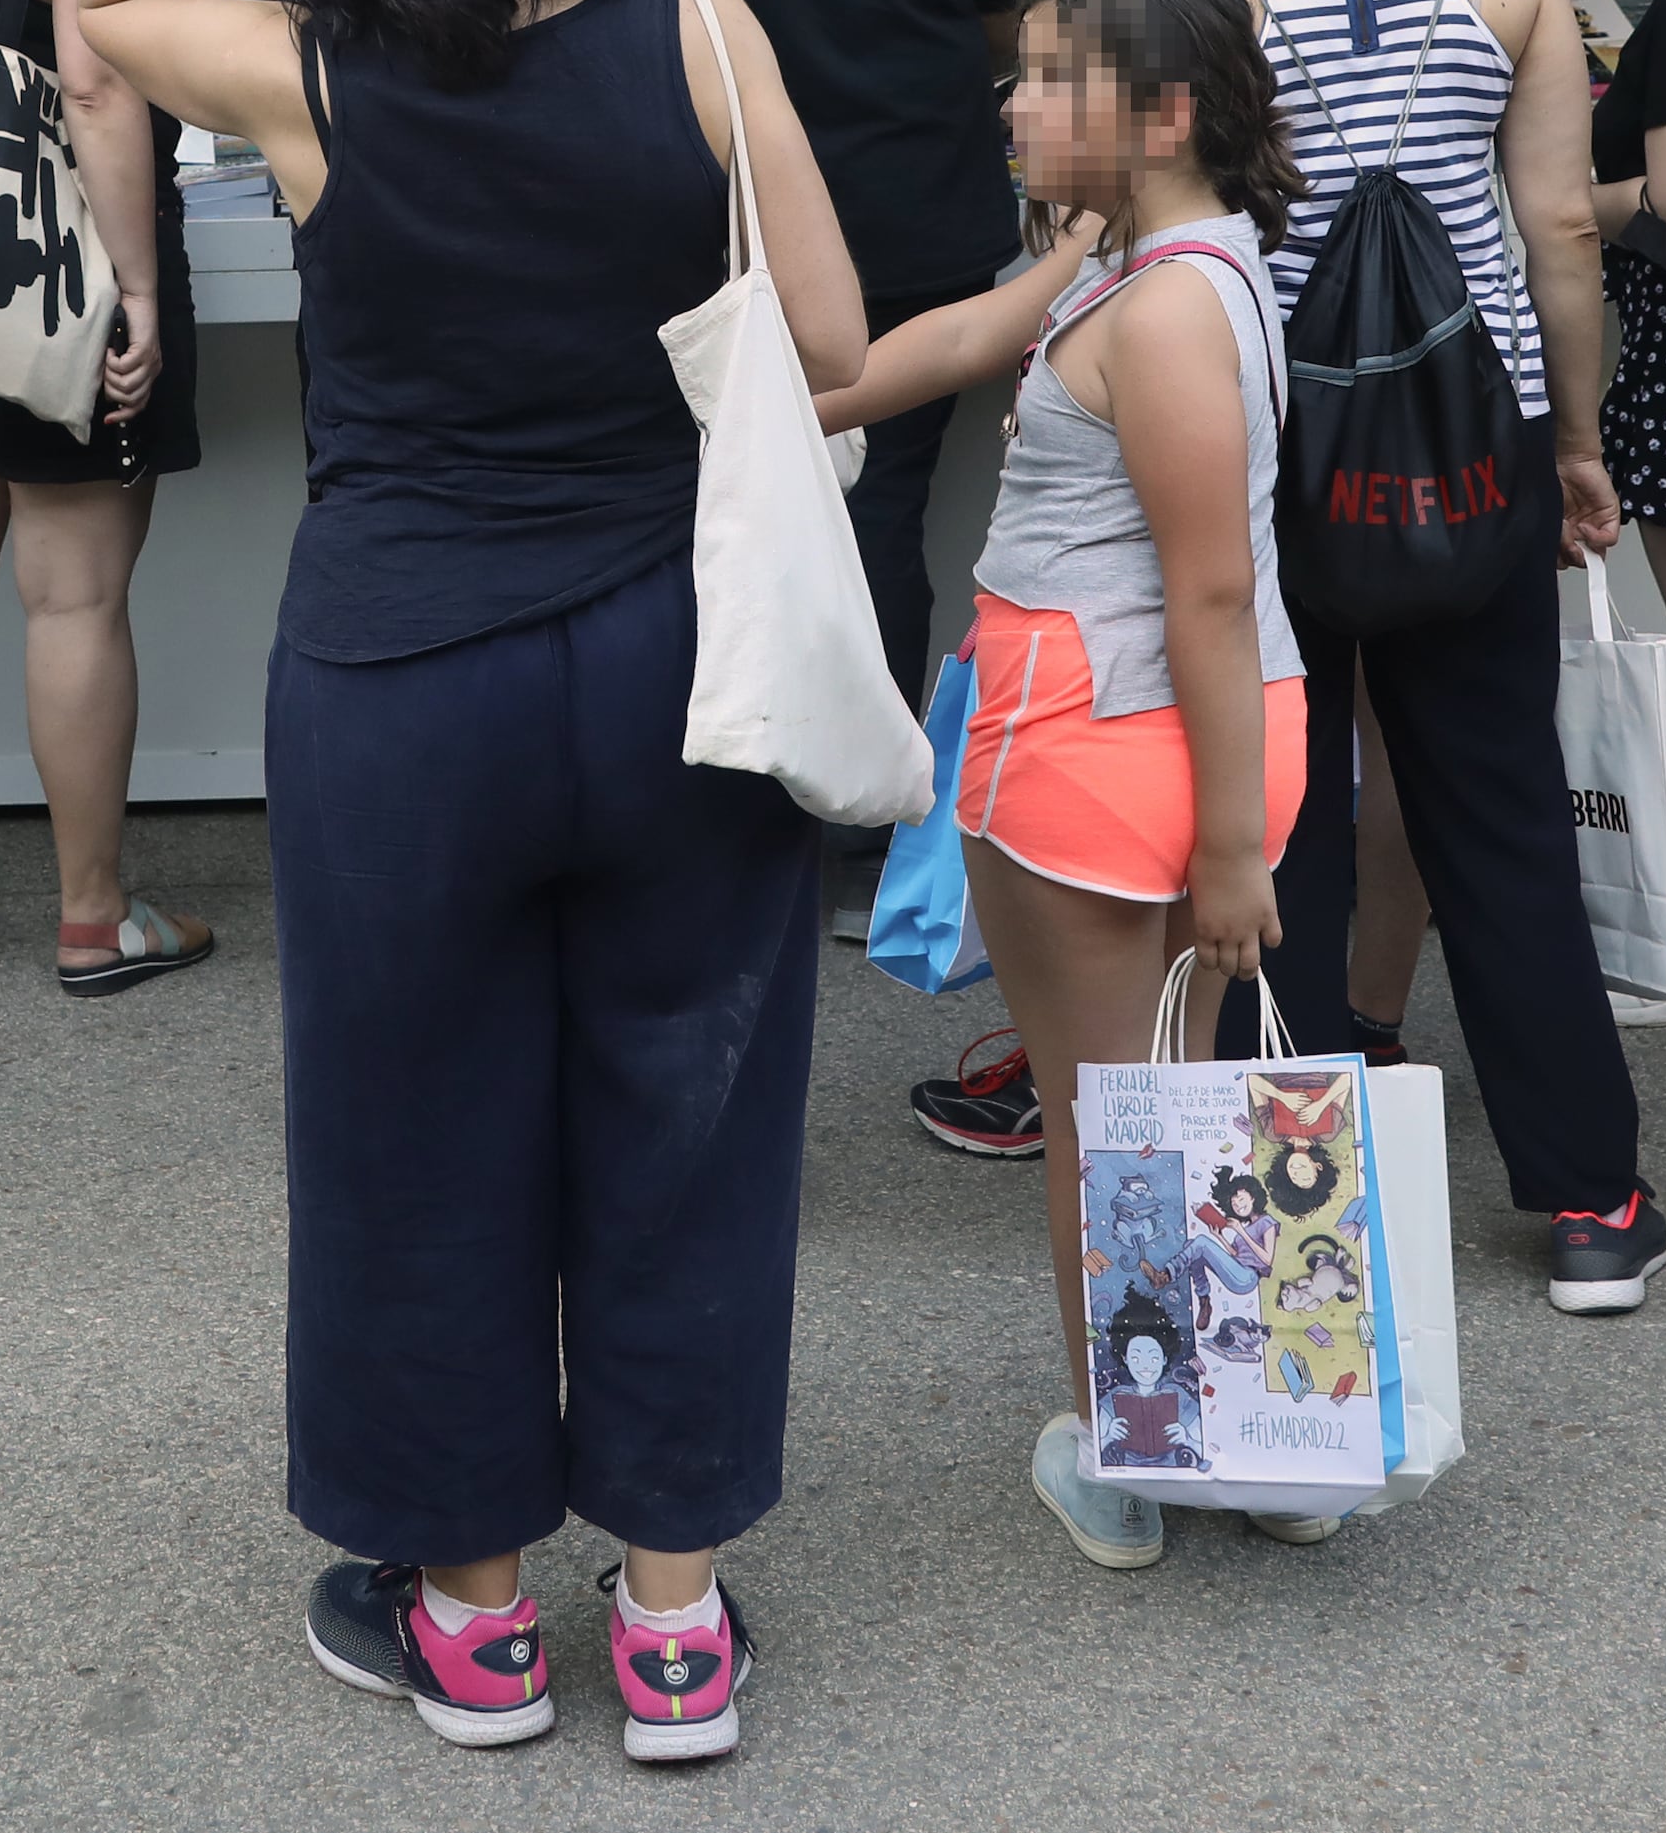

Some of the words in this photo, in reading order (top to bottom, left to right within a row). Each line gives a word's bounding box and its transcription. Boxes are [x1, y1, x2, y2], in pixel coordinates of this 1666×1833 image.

[1329, 454, 1508, 527] NETFLIX
[1567, 789, 1630, 834] BERRI
[1100, 1068, 1137, 1094] FERIA
[1139, 1069, 1161, 1094] DEL
[1168, 1086, 1184, 1097] DEL
[1186, 1086, 1199, 1096] 27
[1200, 1086, 1211, 1096] DE
[1212, 1085, 1237, 1096] MAYO
[1104, 1095, 1142, 1118] LIBRO
[1143, 1096, 1158, 1116] DE
[1171, 1098, 1183, 1107] AL
[1186, 1098, 1196, 1108] 12
[1198, 1098, 1209, 1107] DE
[1211, 1097, 1242, 1107] JUNIO
[1105, 1118, 1164, 1146] MADRID
[1180, 1114, 1217, 1127] PARQUE
[1218, 1114, 1227, 1125] DE
[1183, 1130, 1192, 1141] EL
[1193, 1129, 1228, 1141] RETIRO
[1239, 1411, 1350, 1450] #FLMADRID22
